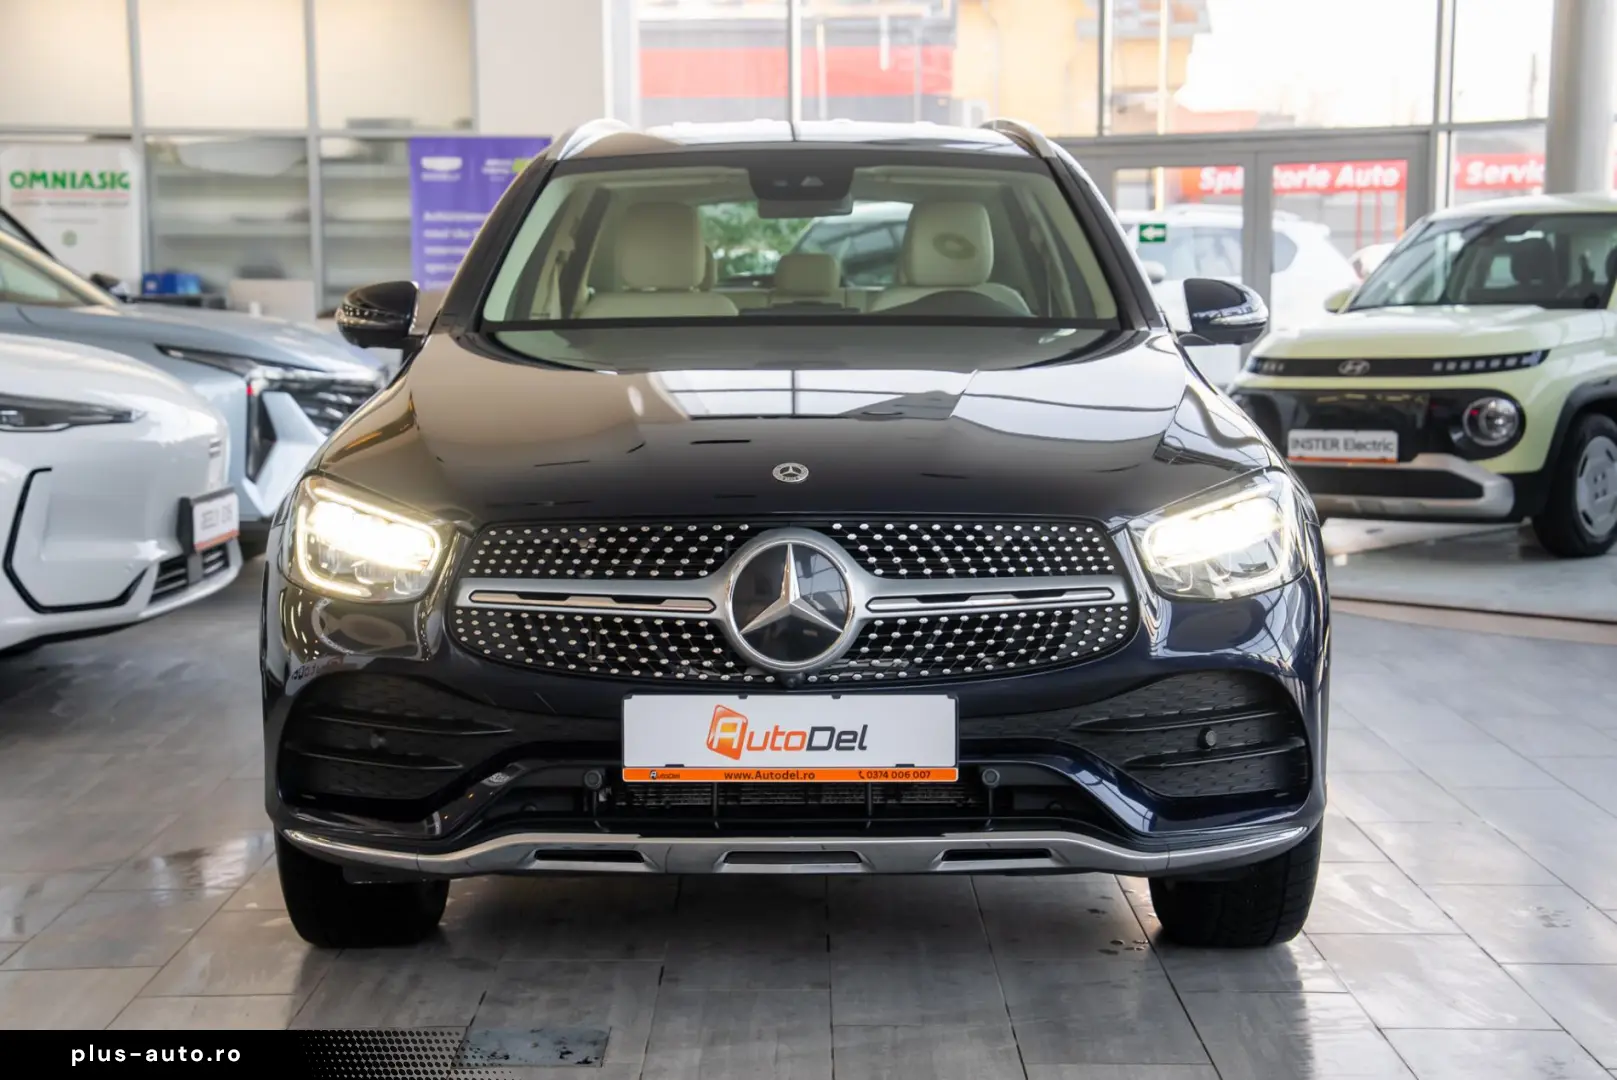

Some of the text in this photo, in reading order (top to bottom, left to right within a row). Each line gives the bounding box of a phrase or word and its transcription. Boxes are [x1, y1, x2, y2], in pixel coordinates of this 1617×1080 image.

[9, 169, 130, 190] OMNIASIG
[1334, 163, 1400, 188] Auto
[1343, 437, 1394, 452] Electric
[709, 712, 868, 753] AutoDel
[723, 769, 816, 780] www.Autodel.ro
[866, 770, 931, 779] 0374 006 007
